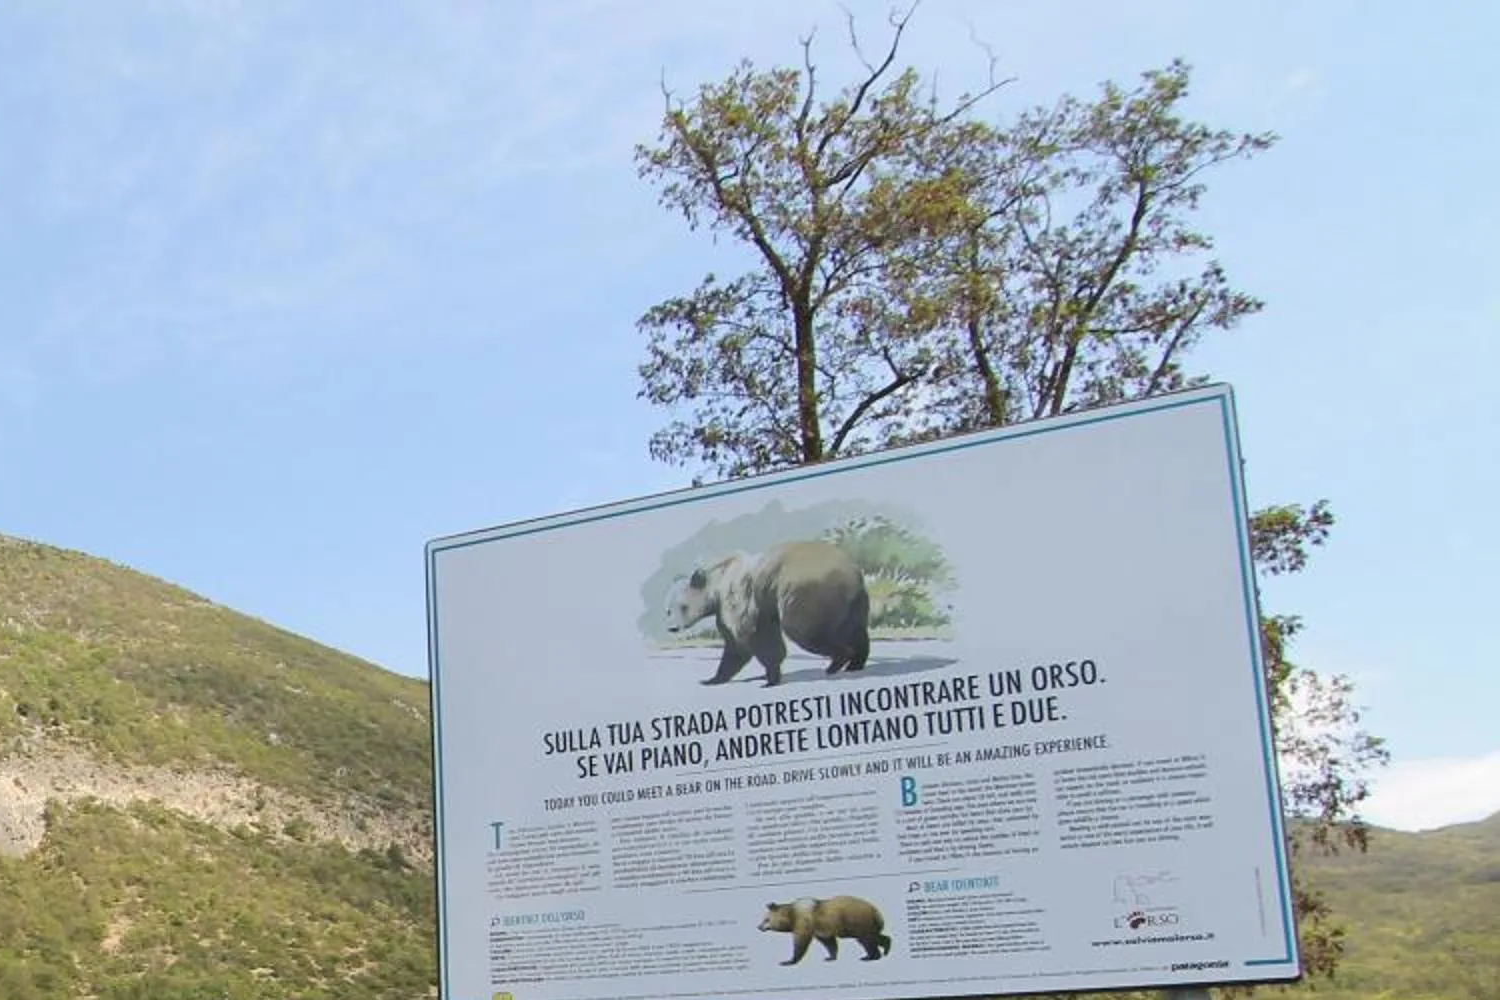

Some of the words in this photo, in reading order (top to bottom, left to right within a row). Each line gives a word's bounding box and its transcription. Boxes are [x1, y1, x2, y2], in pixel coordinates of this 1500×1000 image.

[543, 727, 601, 755] SULLA
[607, 720, 645, 747] TUA
[651, 709, 728, 741] STRADA
[735, 694, 831, 730] POTRESTI
[841, 675, 981, 717] INCONTRARE
[989, 669, 1022, 698] UN
[1031, 659, 1106, 692] ORSO.
[577, 755, 599, 779] SE
[604, 750, 634, 775] VAI
[641, 741, 709, 770] PIANO,
[715, 728, 809, 762] ANDRETE
[817, 714, 918, 750] LONTANO
[924, 705, 985, 737] TUTTI
[993, 703, 1006, 728] E
[1011, 696, 1067, 726] DUE.
[544, 797, 575, 812] TODAY
[577, 794, 599, 808] YOU
[601, 789, 635, 806] COULD
[637, 786, 664, 801] MEET
[665, 785, 674, 798] A
[676, 781, 701, 796] BEAR
[705, 779, 722, 793] ON
[725, 776, 744, 790] THE
[783, 768, 816, 784] DRIVE
[818, 764, 862, 781] SLOWLY
[865, 760, 890, 776] AND
[892, 758, 903, 772] IT
[905, 755, 933, 770] WILL
[937, 752, 951, 767] BE
[955, 750, 972, 765] AN
[975, 743, 1031, 762] AMAZING
